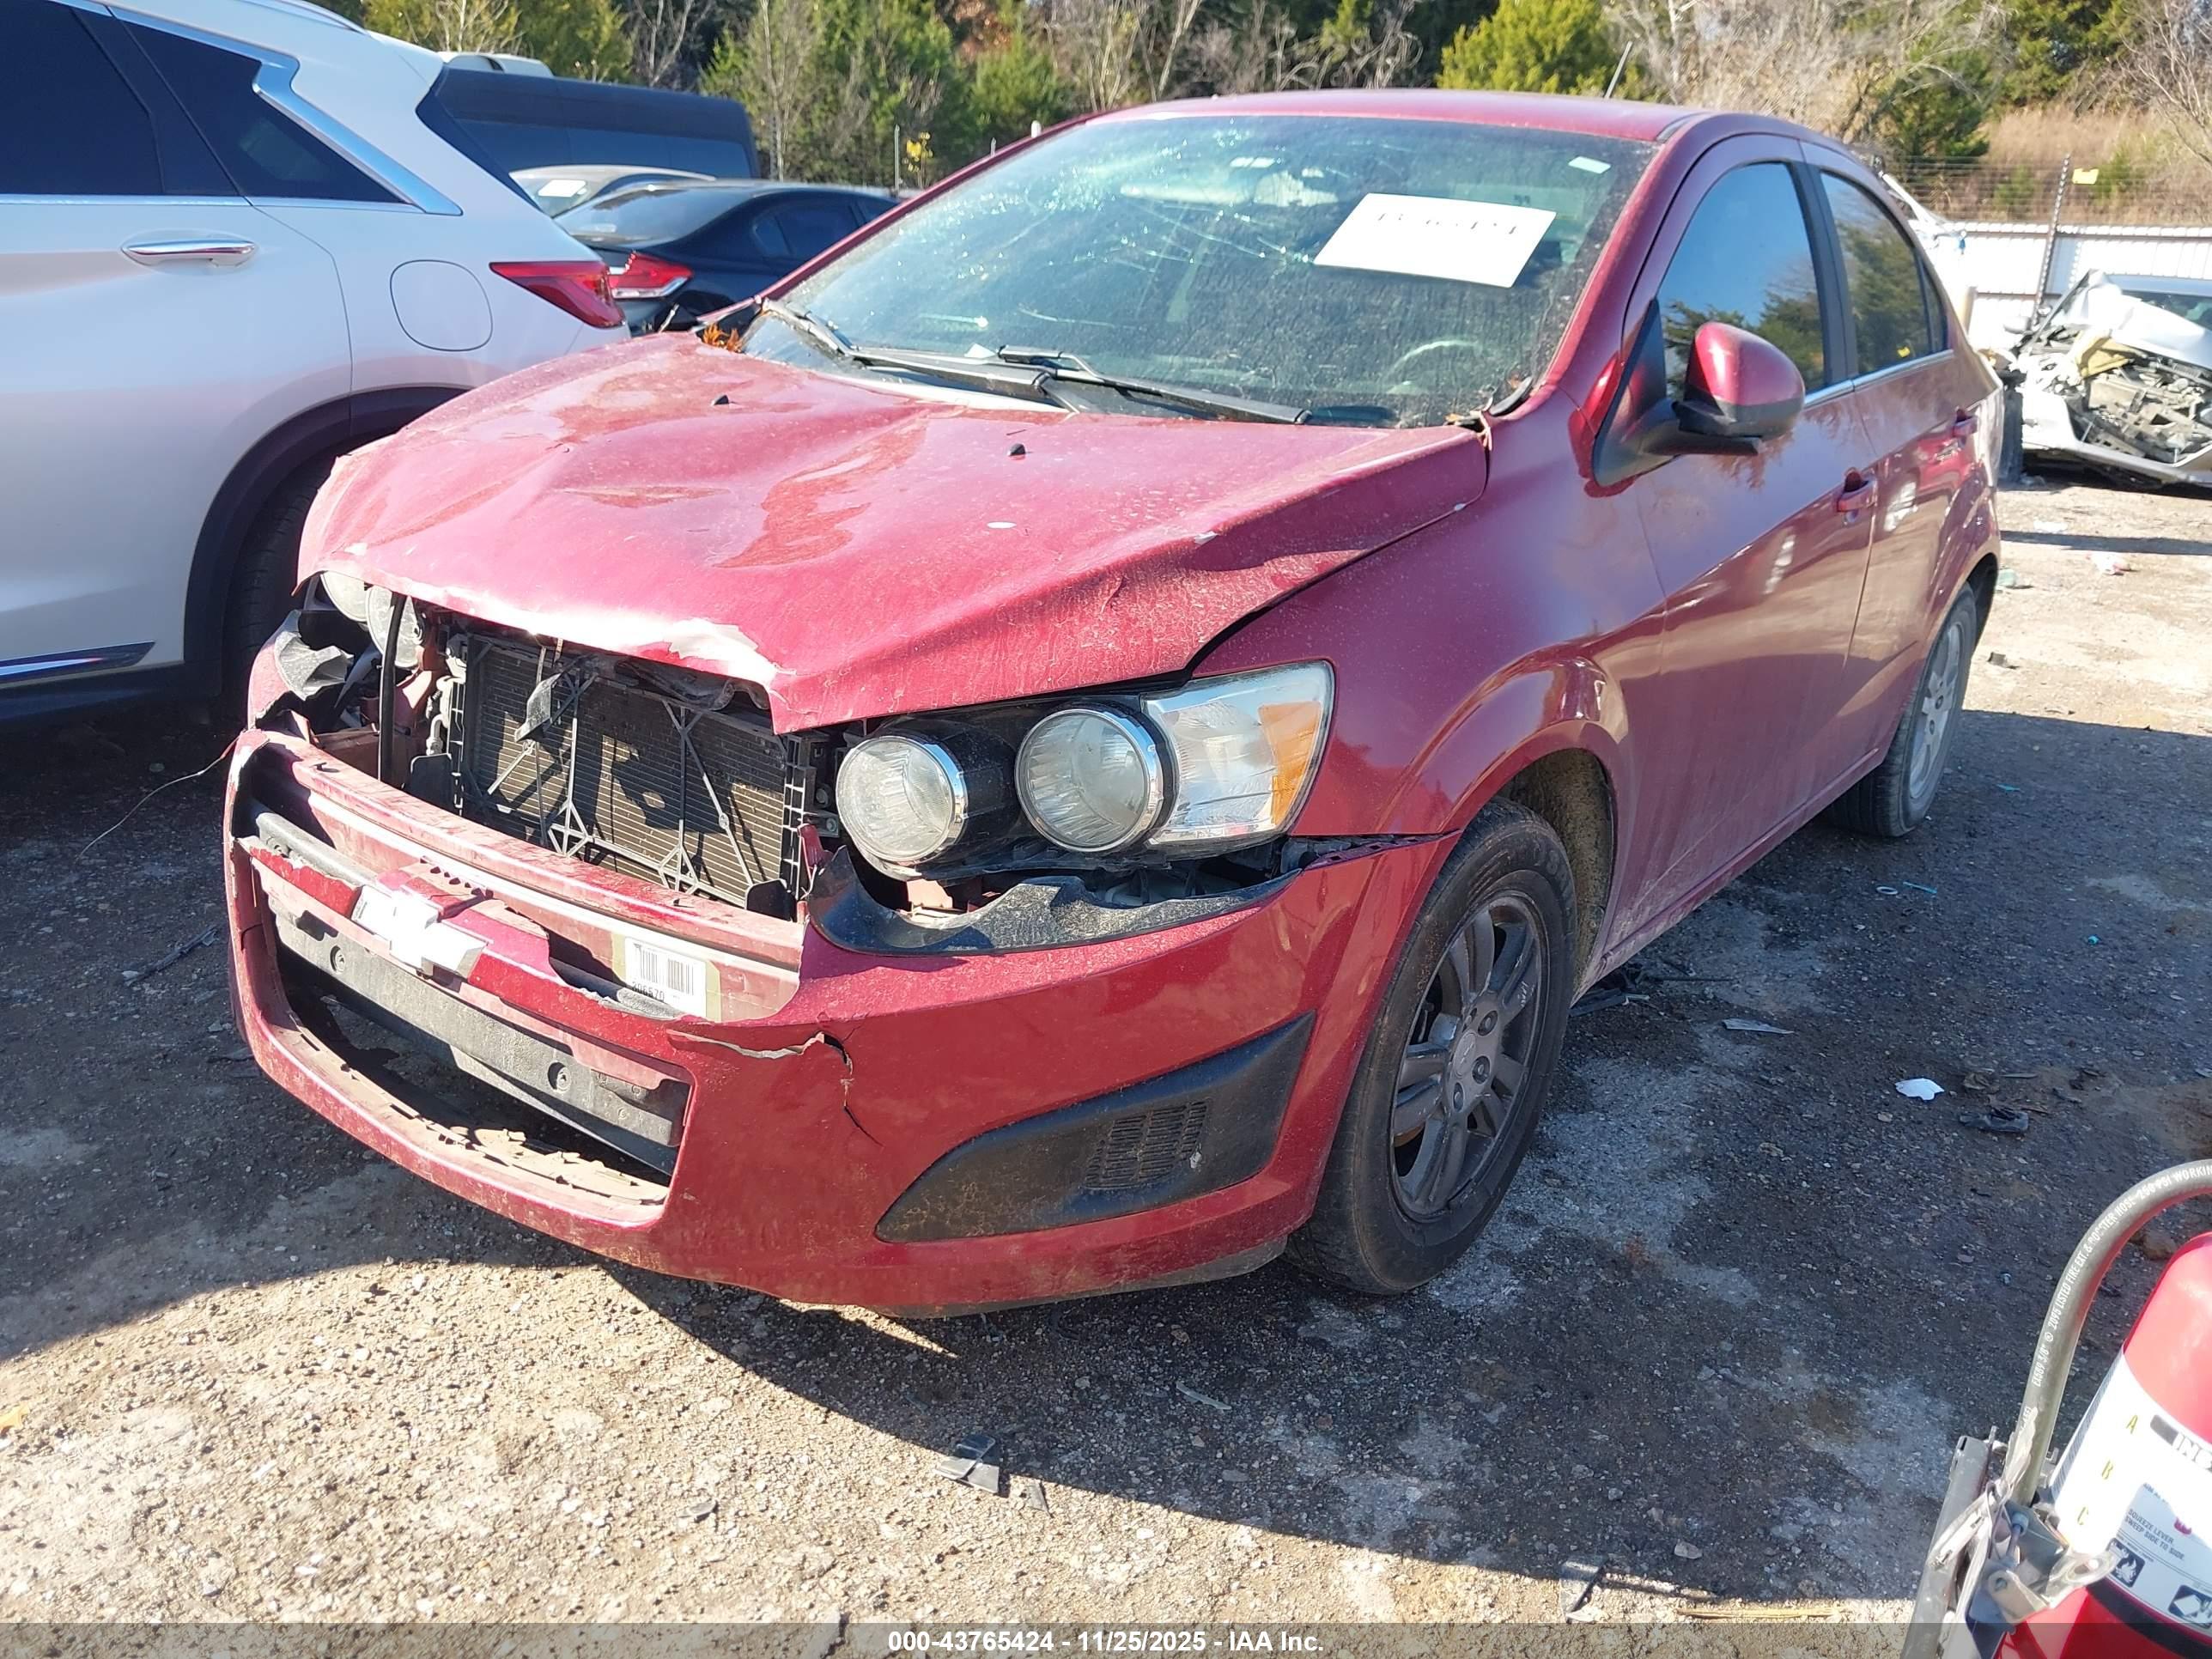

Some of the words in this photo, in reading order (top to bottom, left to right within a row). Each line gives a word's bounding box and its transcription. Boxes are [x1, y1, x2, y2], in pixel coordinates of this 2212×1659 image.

[2055, 1283, 2071, 1309] LISTED
[2065, 1267, 2081, 1285] FIRE
[2125, 1414, 2138, 1435] A
[2101, 1460, 2114, 1480] B
[2124, 1516, 2144, 1533] SWEEP
[2144, 1531, 2159, 1544] SIDE
[2160, 1540, 2169, 1551] TO
[2129, 1509, 2154, 1530] SQUEEZE
[2154, 1528, 2174, 1544] LEVER
